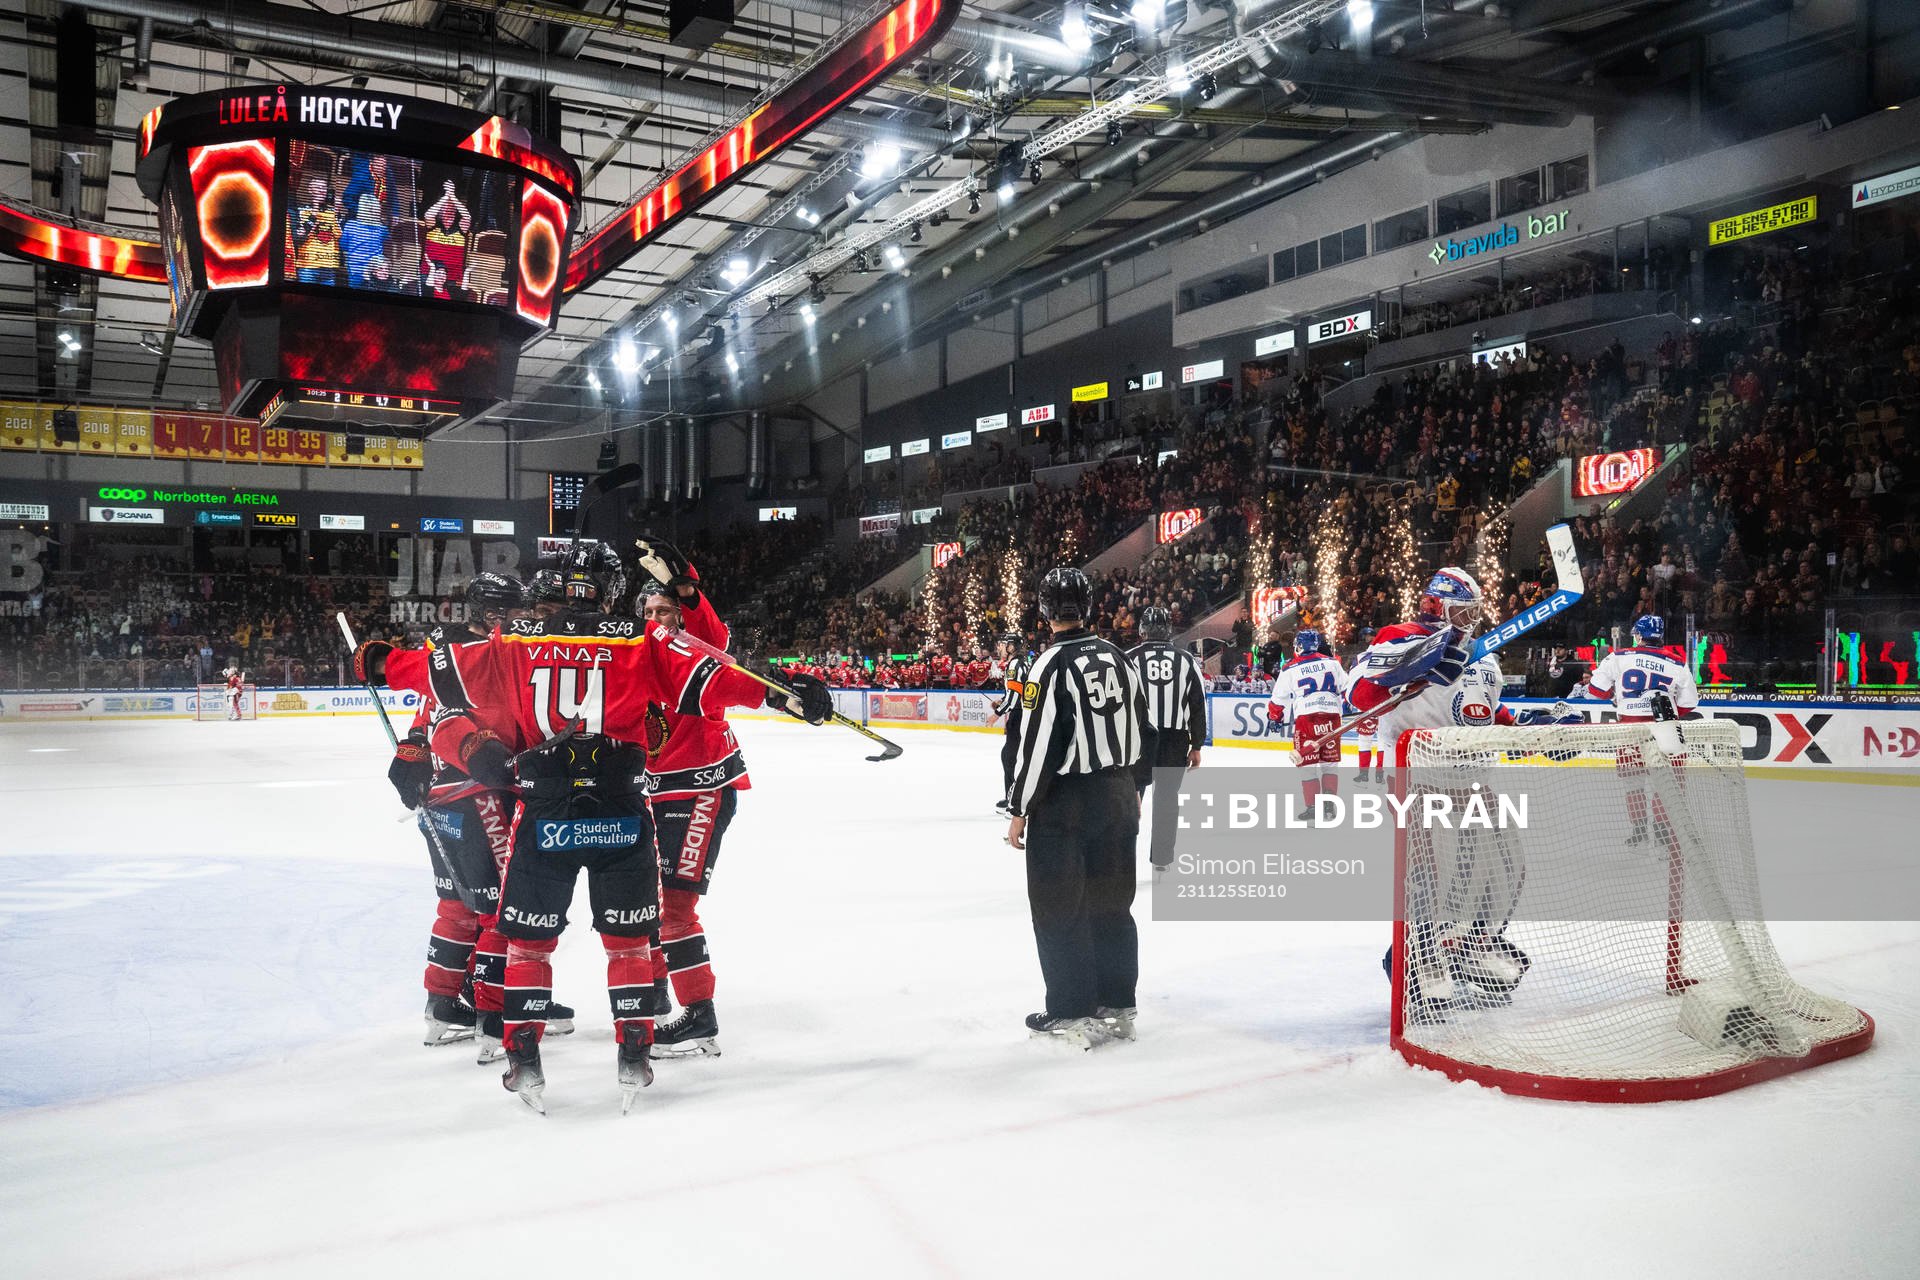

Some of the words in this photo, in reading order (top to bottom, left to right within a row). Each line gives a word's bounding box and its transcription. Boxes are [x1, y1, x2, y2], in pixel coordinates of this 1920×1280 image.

[219, 85, 289, 124] LULEÅ
[300, 95, 404, 130] HOCKEY
[1716, 212, 1769, 231] SOLENS
[1772, 201, 1809, 219] STAD
[1716, 219, 1778, 240] FOLKETS
[1781, 211, 1809, 224] LAG
[1446, 223, 1519, 261] bravida
[1527, 210, 1570, 239] bar
[1319, 315, 1360, 339] BDX
[334, 393, 341, 402] 2
[350, 394, 365, 404] LHF
[423, 401, 429, 410] 0
[5, 418, 33, 429] 2021
[1027, 407, 1049, 422] ABB
[84, 422, 110, 434] 2018
[121, 424, 147, 437] 2016
[165, 423, 176, 442] 4
[201, 424, 212, 444] 7
[233, 427, 251, 446] 12
[265, 429, 289, 449] 28
[299, 432, 322, 449] 35
[364, 438, 387, 449] 2012
[1590, 455, 1641, 485] LULEÅ
[99, 487, 147, 503] coop
[153, 490, 227, 504] Norrbotten
[233, 493, 279, 506] ARENA
[116, 511, 153, 520] SCANIA
[256, 514, 296, 523] TITAN
[388, 537, 521, 597] JIAB
[575, 585, 586, 598] 14
[510, 618, 545, 635] SSAB
[597, 620, 635, 636] SSAB
[1146, 659, 1174, 681] 68
[1300, 662, 1327, 676] PALOLA
[1635, 658, 1665, 673] OLESEN
[1083, 666, 1124, 710] 54
[1621, 668, 1674, 698] 95
[529, 667, 604, 742] 14
[1777, 694, 1804, 702] NYAB
[693, 766, 727, 786] SSAB
[541, 822, 571, 849] SC
[573, 820, 622, 834] Student
[573, 832, 638, 846] Consulting
[517, 911, 559, 929] LKAB
[620, 905, 657, 924] LKAB
[523, 998, 549, 1012] NEX
[617, 998, 642, 1011] NEX
